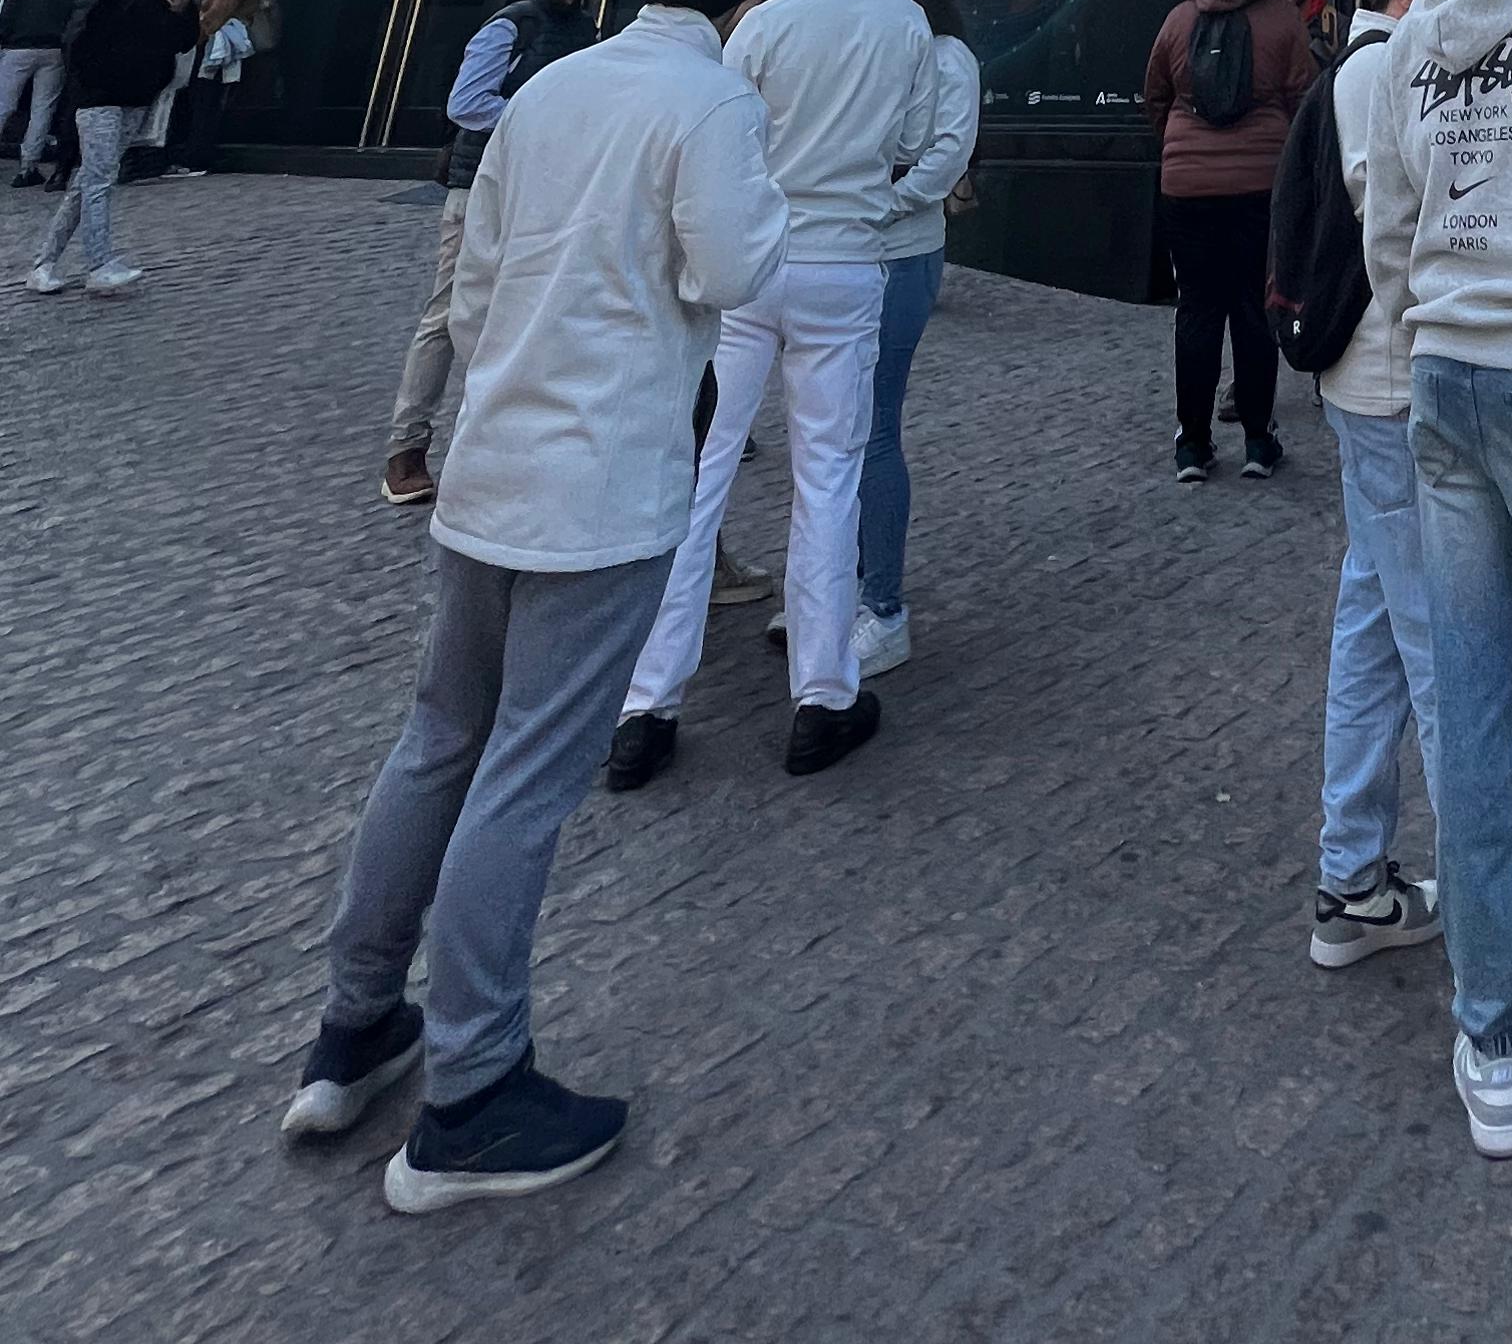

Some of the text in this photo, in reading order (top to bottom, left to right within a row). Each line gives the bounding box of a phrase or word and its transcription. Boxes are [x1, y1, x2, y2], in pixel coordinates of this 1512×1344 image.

[1440, 104, 1508, 123] NEW YORK
[1450, 150, 1494, 165] TOKYO
[1443, 214, 1498, 229] LONDON
[1450, 237, 1488, 251] PARIS
